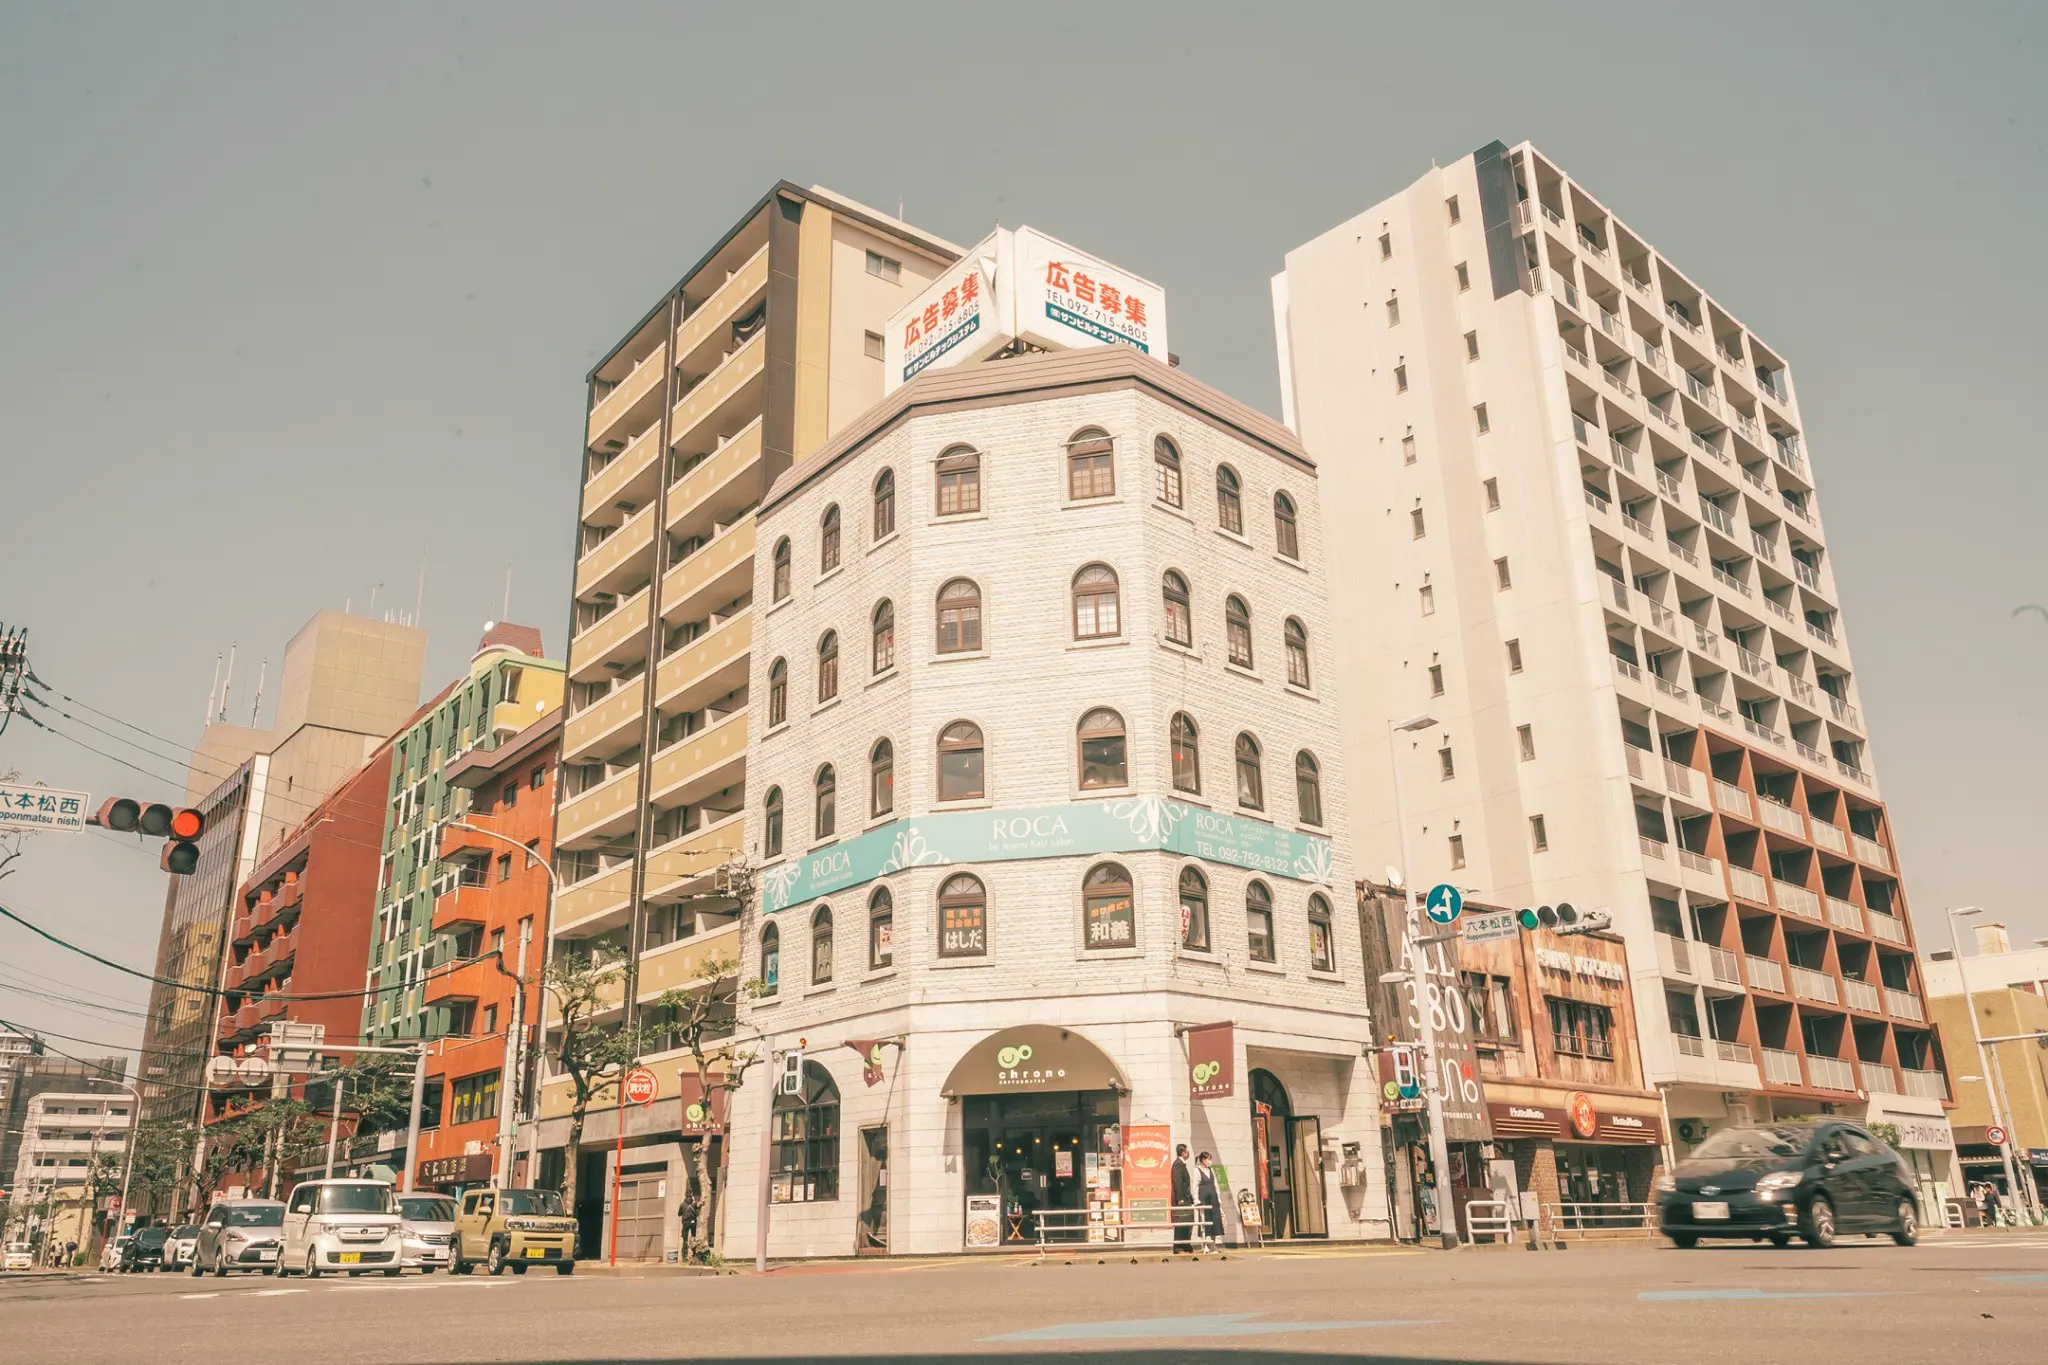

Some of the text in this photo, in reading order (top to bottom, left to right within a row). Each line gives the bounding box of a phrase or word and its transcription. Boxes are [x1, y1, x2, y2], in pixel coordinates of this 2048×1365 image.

[1046, 261, 1147, 327] 広告募集
[903, 271, 979, 349] 広告募集
[1046, 288, 1148, 342] TEL 092-715-6805
[904, 300, 979, 363] TEL 092-715-6805
[0, 790, 81, 815] 六本松西
[57, 816, 80, 826] nishi
[992, 815, 1069, 839] ROCA
[1196, 813, 1234, 837] ROCA
[812, 849, 851, 880] ROCA
[1196, 841, 1289, 873] TEL 092-752-8122
[1090, 920, 1130, 941] 和義
[1466, 915, 1513, 933] 六本松西
[945, 929, 982, 949] はしだ
[1403, 980, 1466, 1035] 380
[998, 1069, 1066, 1080] chrono
[628, 1082, 652, 1095] 消火栓
[1191, 1083, 1230, 1093] chrono
